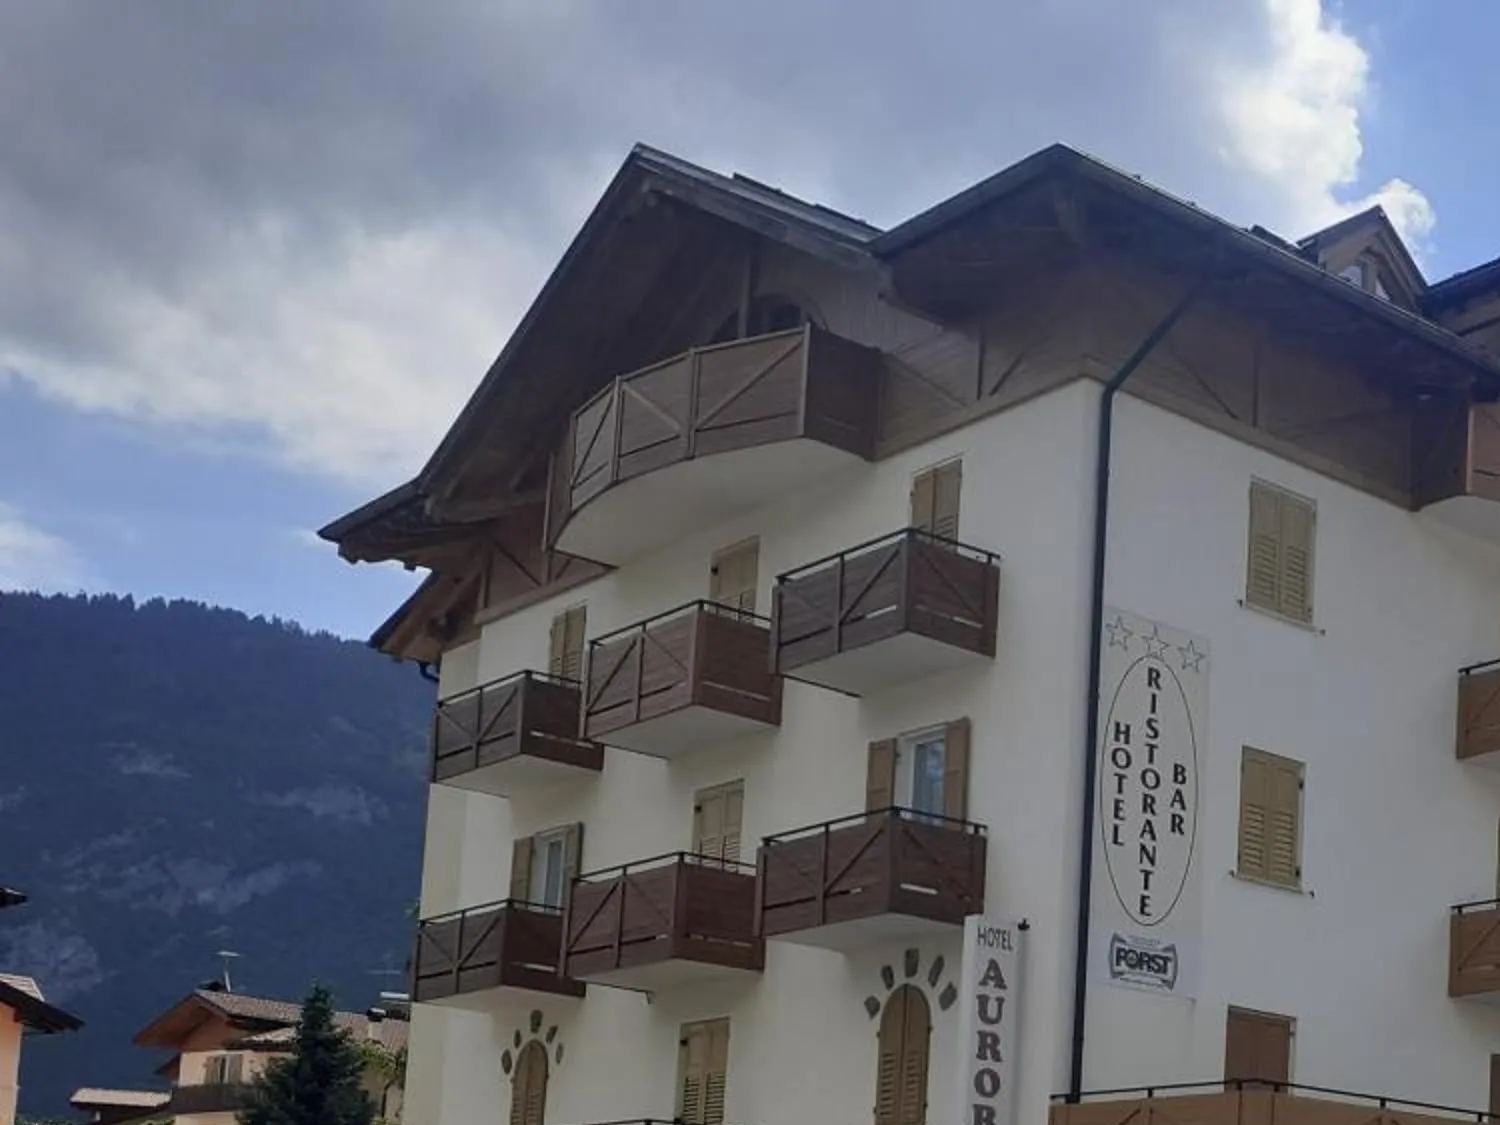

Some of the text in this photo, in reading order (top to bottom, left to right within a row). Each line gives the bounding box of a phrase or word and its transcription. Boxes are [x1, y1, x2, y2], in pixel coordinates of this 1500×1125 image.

[1111, 721, 1132, 847] HOTEL
[1138, 666, 1161, 917] RISTORANTE
[1169, 763, 1187, 836] BAR
[977, 926, 1014, 952] HOTEL
